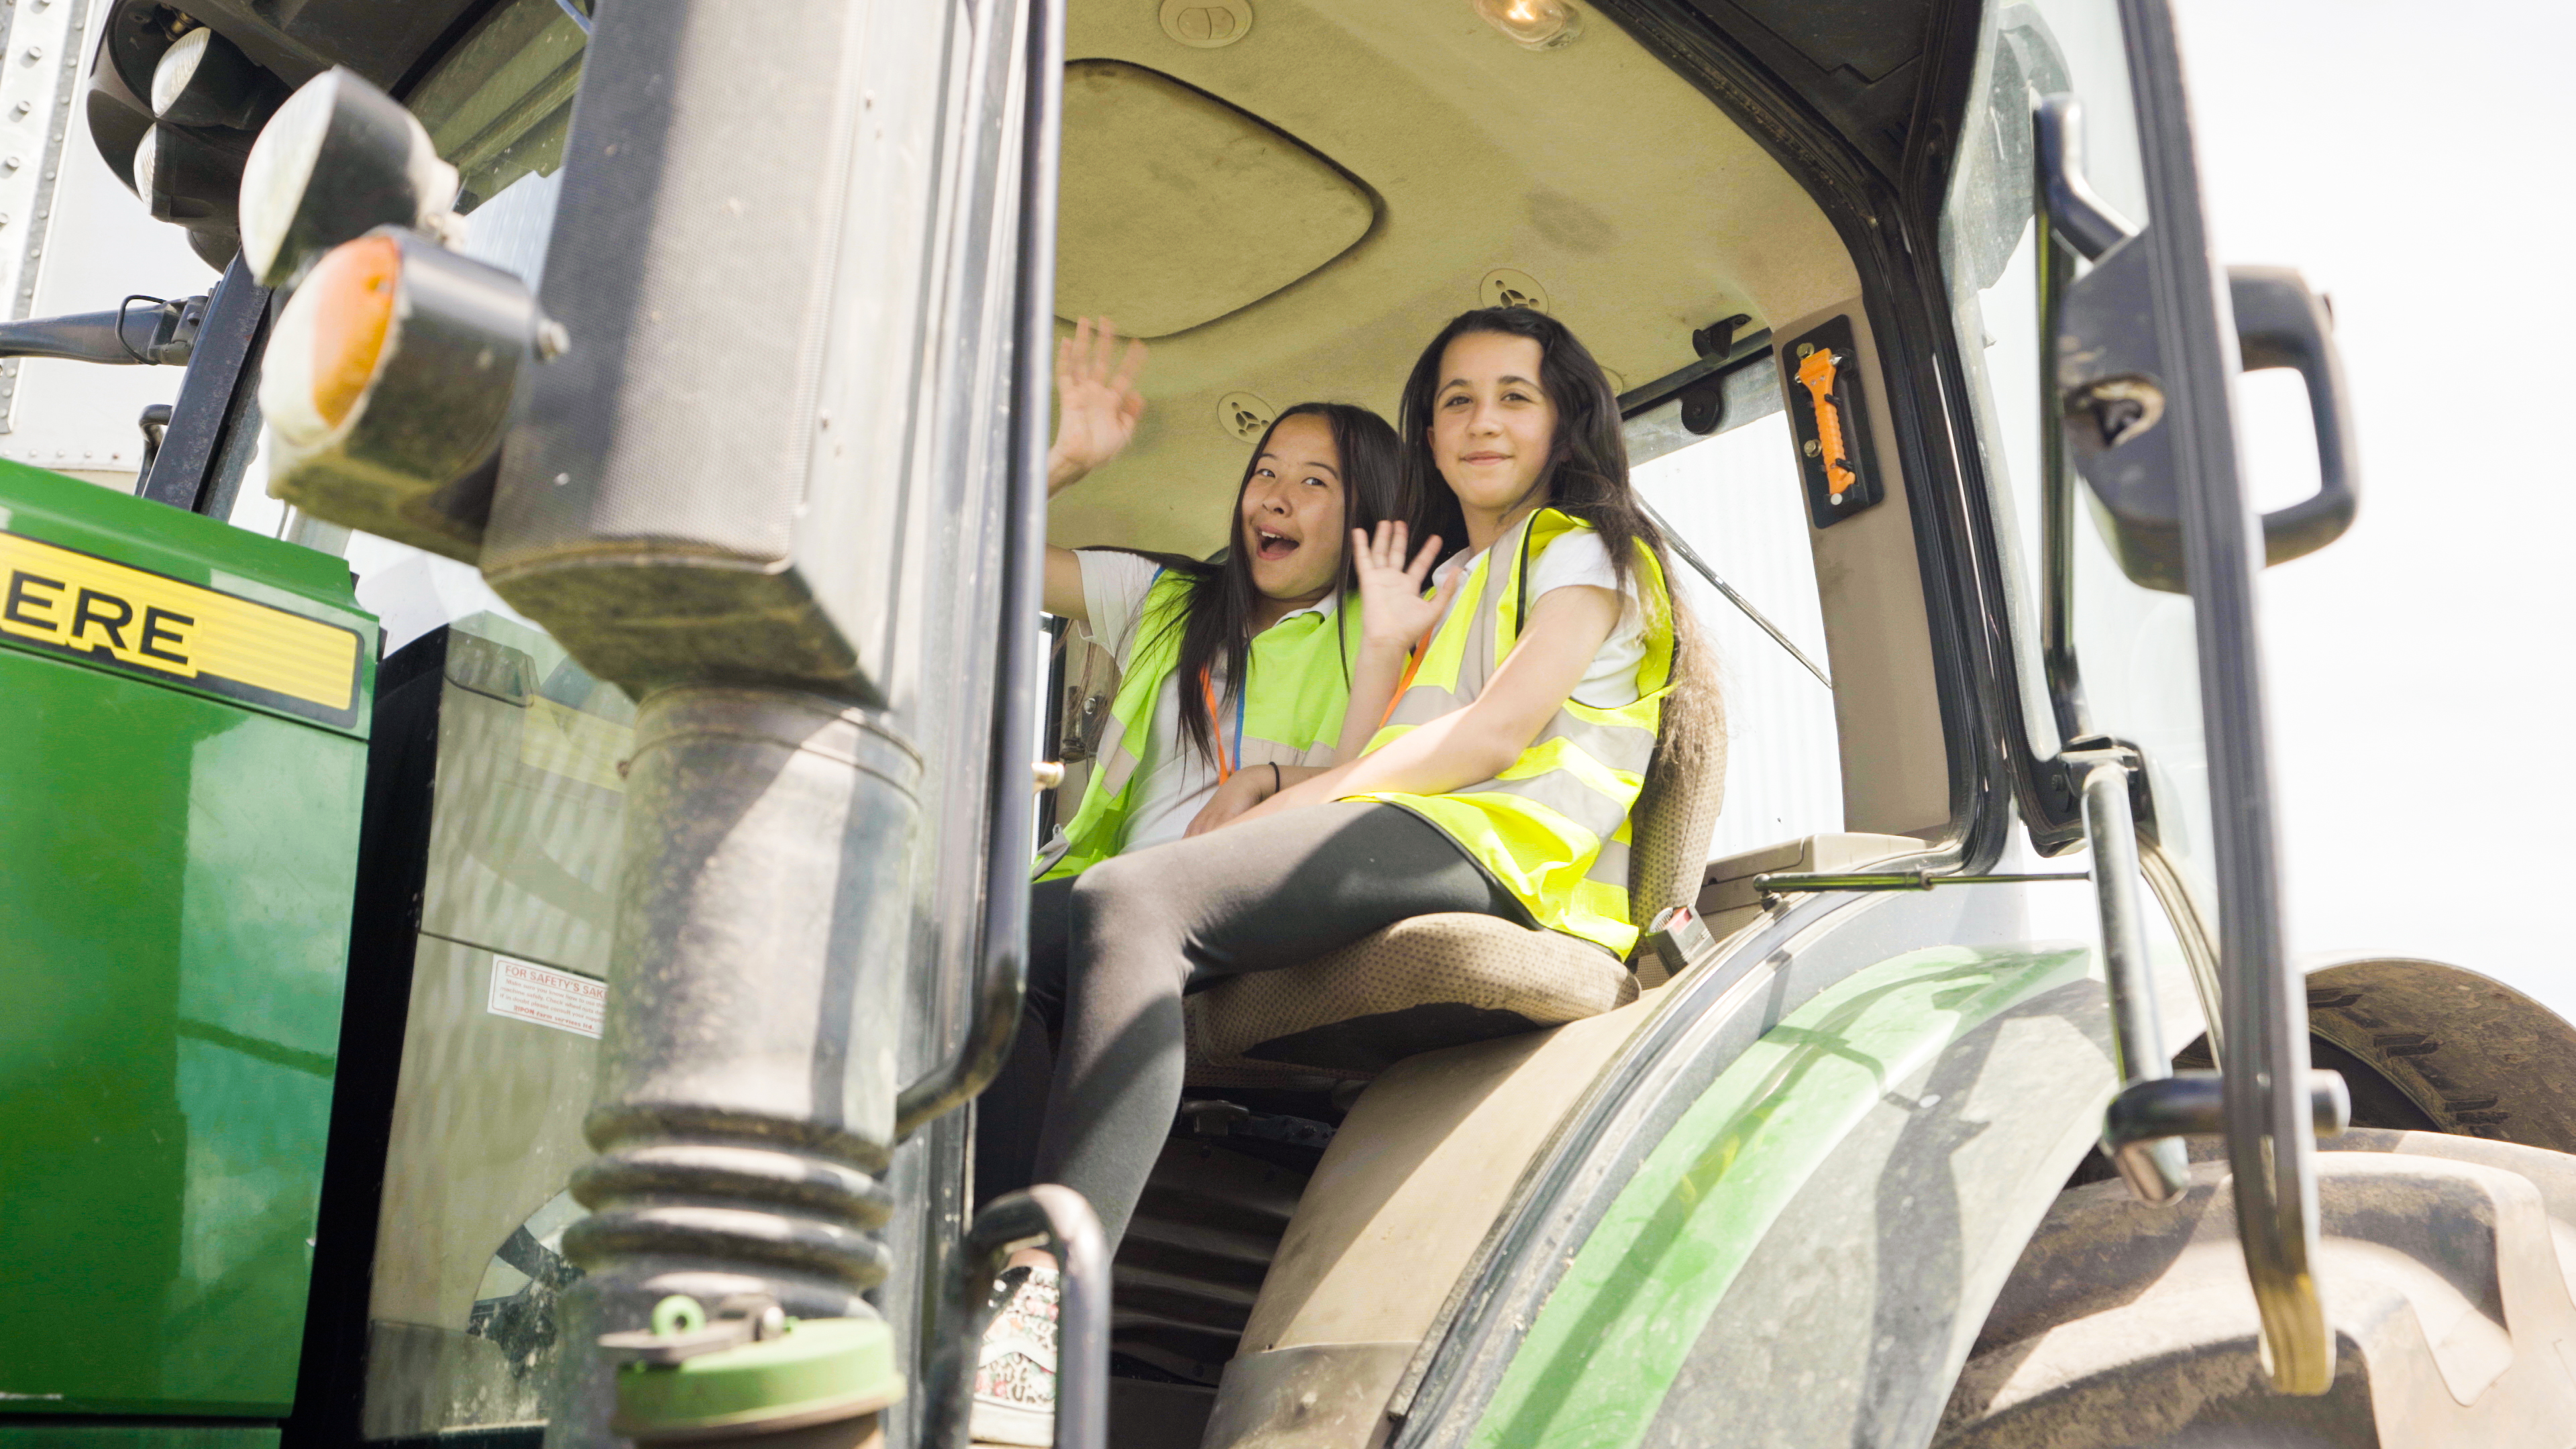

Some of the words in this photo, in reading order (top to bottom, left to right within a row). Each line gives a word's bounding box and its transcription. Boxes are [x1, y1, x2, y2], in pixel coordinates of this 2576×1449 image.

[4, 569, 195, 665] ERE
[505, 965, 527, 978] FOR
[530, 971, 580, 991] SAFETY'S
[506, 979, 521, 987] Make
[549, 989, 564, 998] know
[500, 986, 525, 996] machine
[545, 996, 563, 1005] Check
[565, 1002, 581, 1010] wheel
[513, 997, 530, 1005] doubt
[531, 1001, 549, 1010] please
[550, 1006, 571, 1014] consult
[514, 1005, 535, 1015] RIPON
[536, 1012, 552, 1020] farm
[554, 1016, 581, 1027] services
